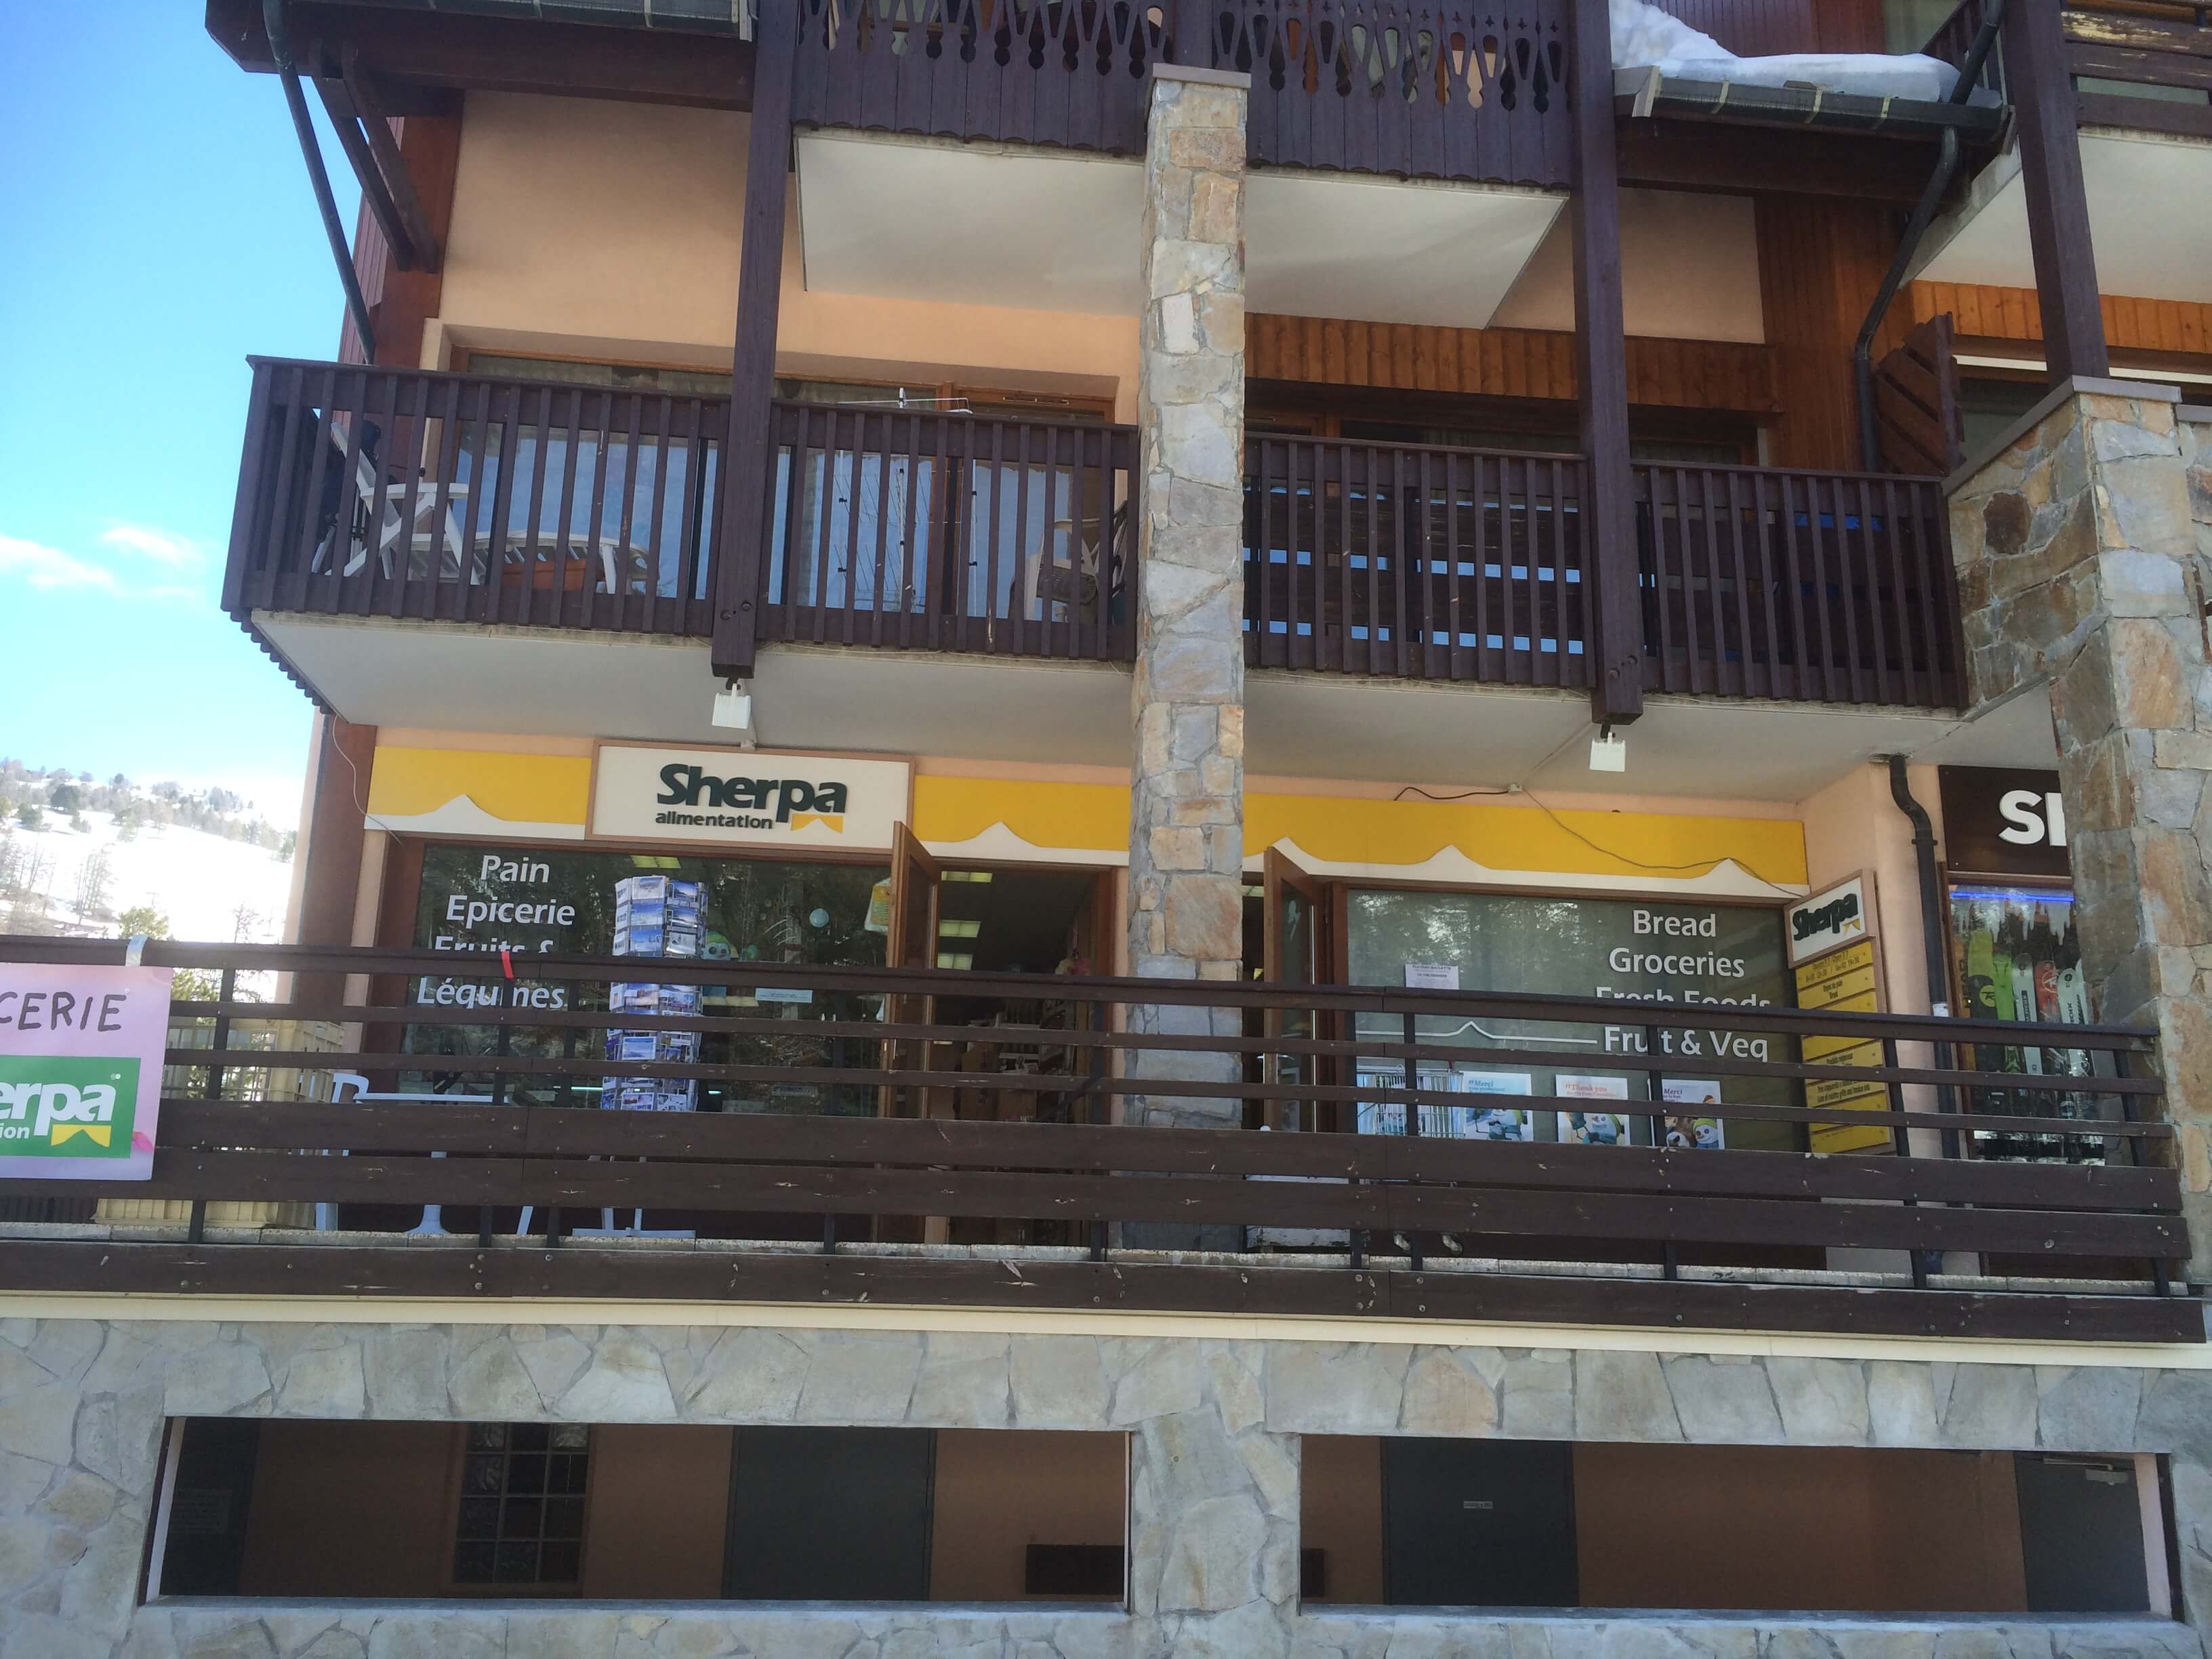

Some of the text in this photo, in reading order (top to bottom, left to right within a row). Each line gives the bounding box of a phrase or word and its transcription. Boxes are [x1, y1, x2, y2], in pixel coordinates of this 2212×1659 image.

[657, 763, 848, 823] Sherpa
[655, 811, 773, 830] alimentation
[480, 855, 550, 883] Pain
[445, 894, 576, 929] Epicerie
[1633, 909, 1717, 938] Bread
[1793, 893, 1858, 941] Sherpa
[1608, 947, 1745, 979] Groceries
[1604, 1026, 1767, 1063] Frut & Veg
